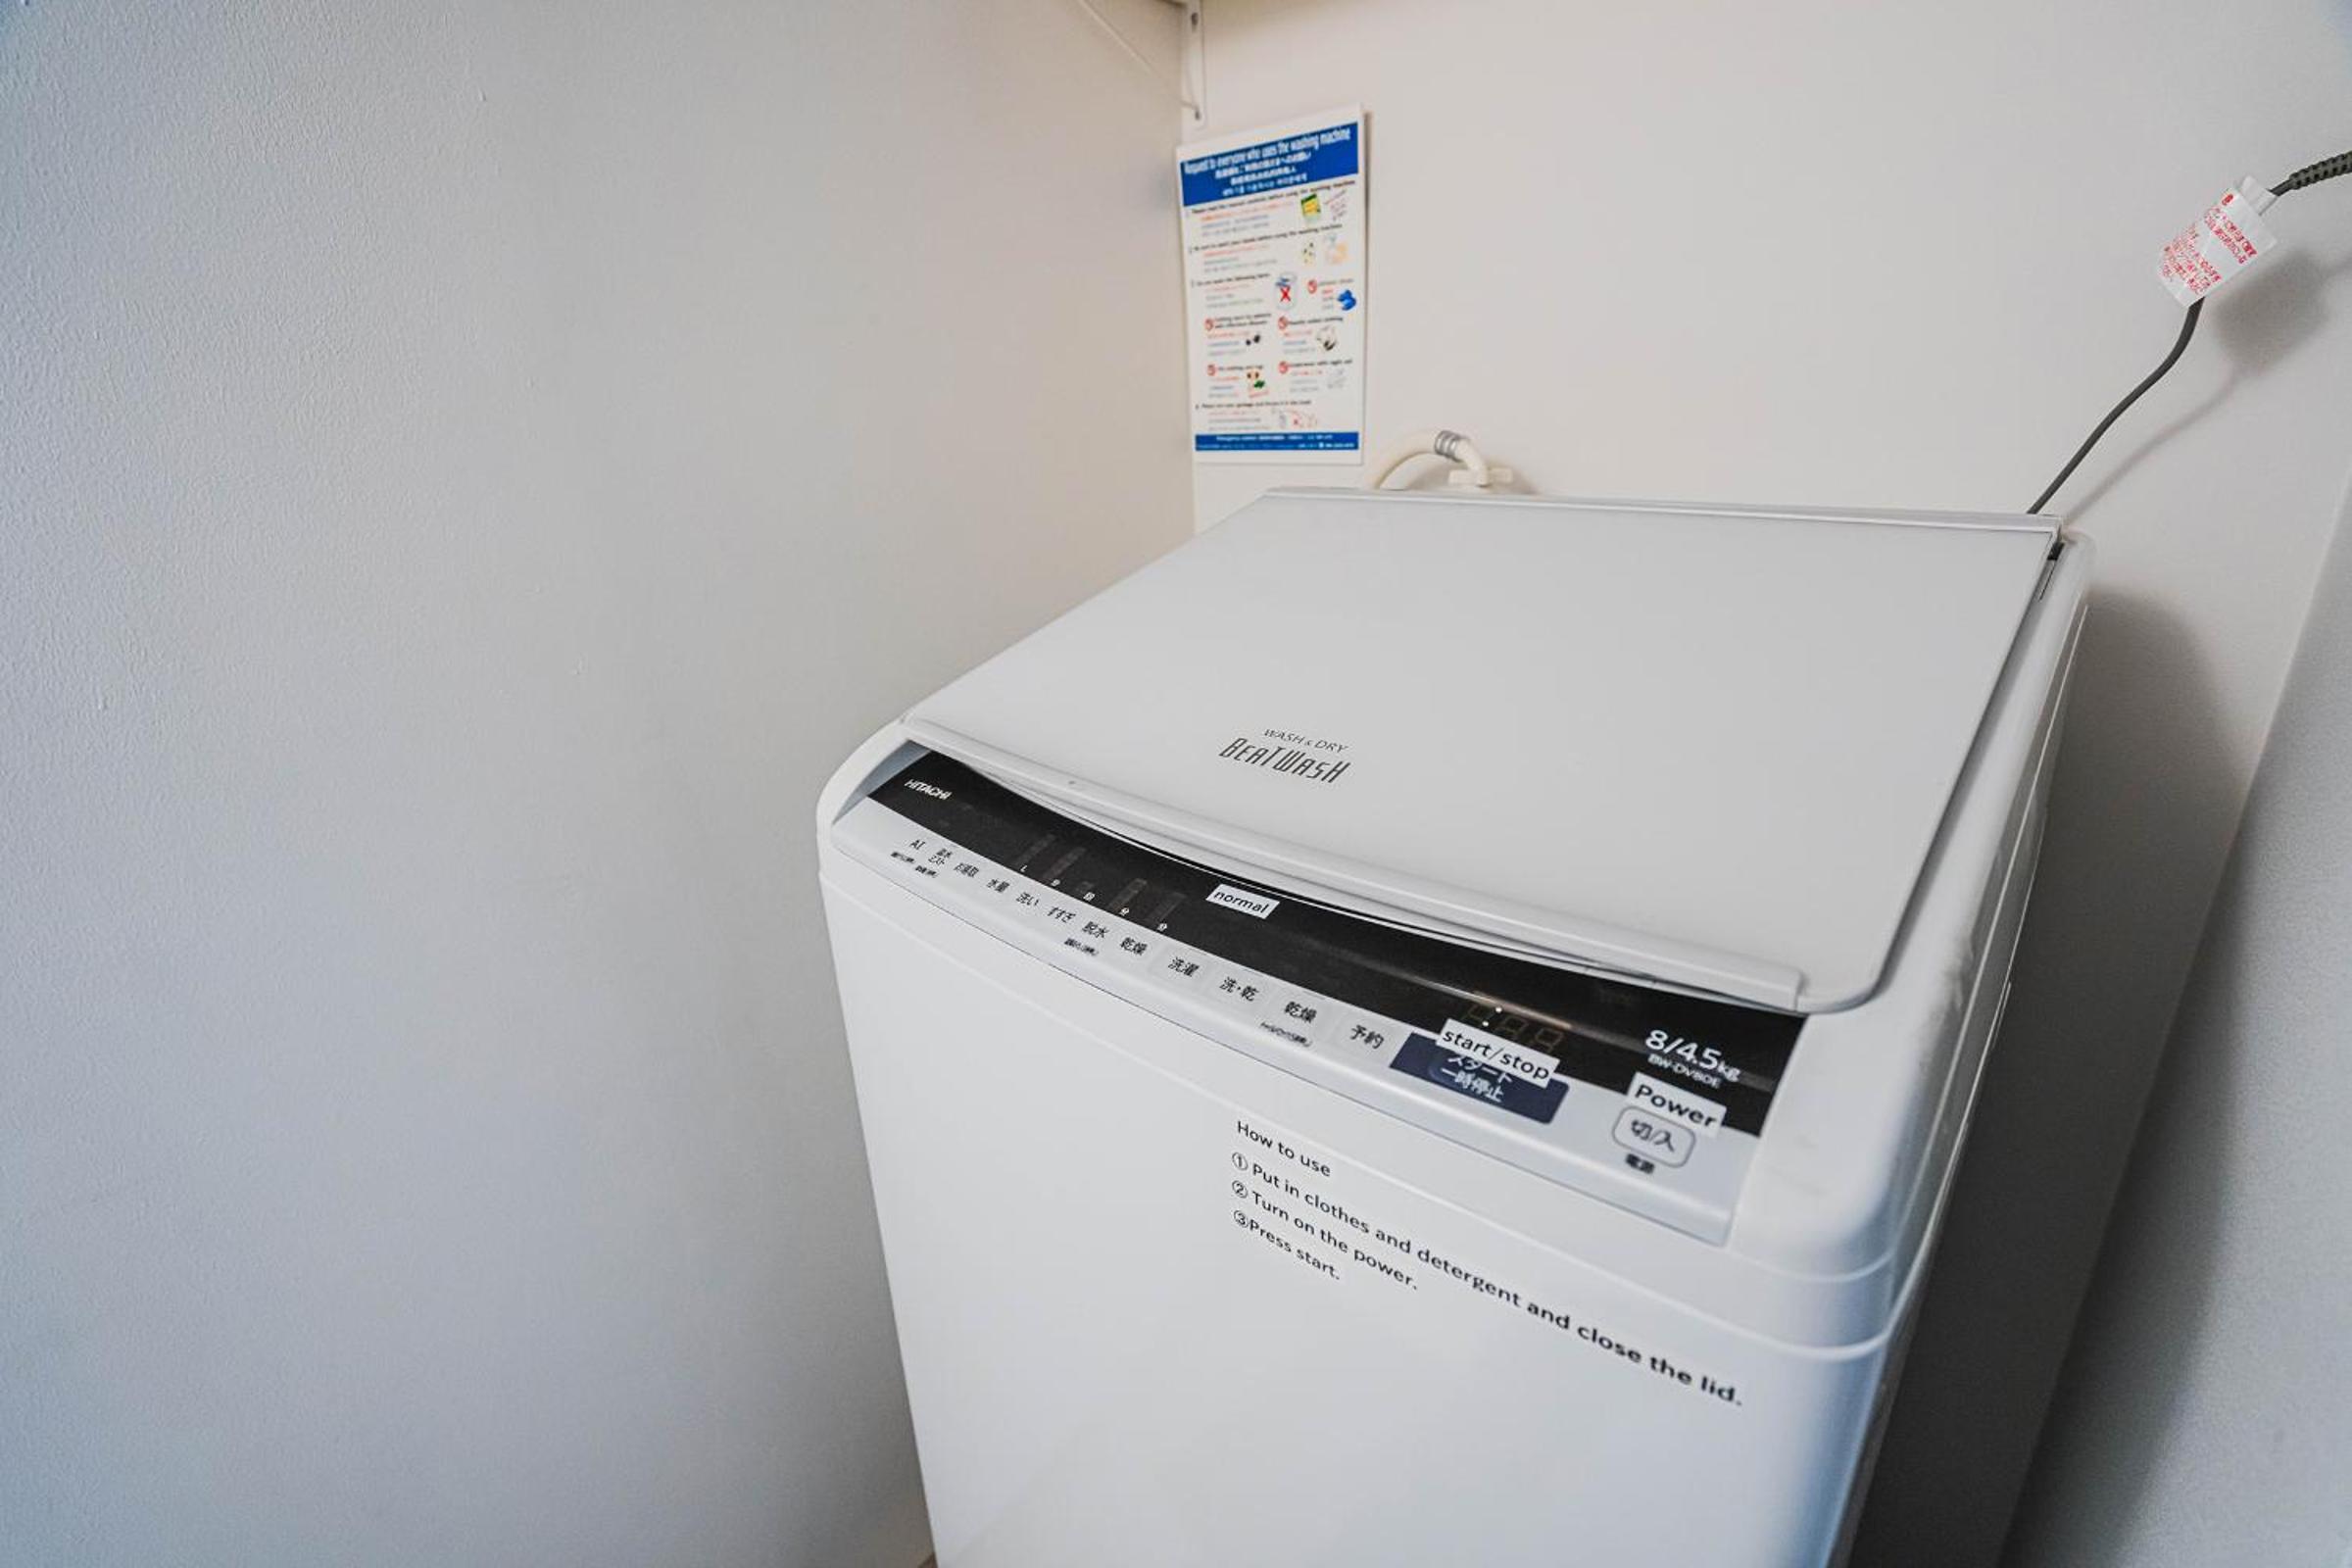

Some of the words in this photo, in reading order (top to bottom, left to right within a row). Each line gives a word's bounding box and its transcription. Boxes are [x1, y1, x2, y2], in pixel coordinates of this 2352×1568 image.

[1263, 728, 1305, 744] WASH
[1314, 739, 1349, 754] DRY
[904, 778, 953, 802] HITACHI
[1213, 889, 1270, 914] normal
[1082, 920, 1109, 938] 脱水
[1120, 937, 1149, 956] 乾燥
[1167, 956, 1200, 977] 洗濯
[1284, 1001, 1318, 1024] 乾燥
[1350, 1024, 1385, 1050] 予約
[1442, 1029, 1550, 1080] start/stop
[1441, 1067, 1504, 1103] 一時停止
[1635, 1084, 1718, 1127] Power
[1237, 1120, 1273, 1150] How
[1277, 1139, 1296, 1160] to
[1299, 1152, 1332, 1178] use
[1630, 1120, 1676, 1153] 切/入
[1251, 1191, 1290, 1221] Turn
[1294, 1214, 1315, 1235] on
[1320, 1227, 1349, 1254] the
[1352, 1247, 1418, 1292] power.
[1296, 1247, 1341, 1281] start.
[1252, 1162, 1281, 1190] Put
[1284, 1176, 1300, 1198] in
[1304, 1190, 1370, 1235] clothes
[1375, 1227, 1412, 1254] and
[1417, 1247, 1523, 1308] detergent
[1526, 1299, 1571, 1331] and
[1577, 1323, 1643, 1363] close
[1649, 1354, 1693, 1386] the
[1700, 1374, 1743, 1406] lid.
